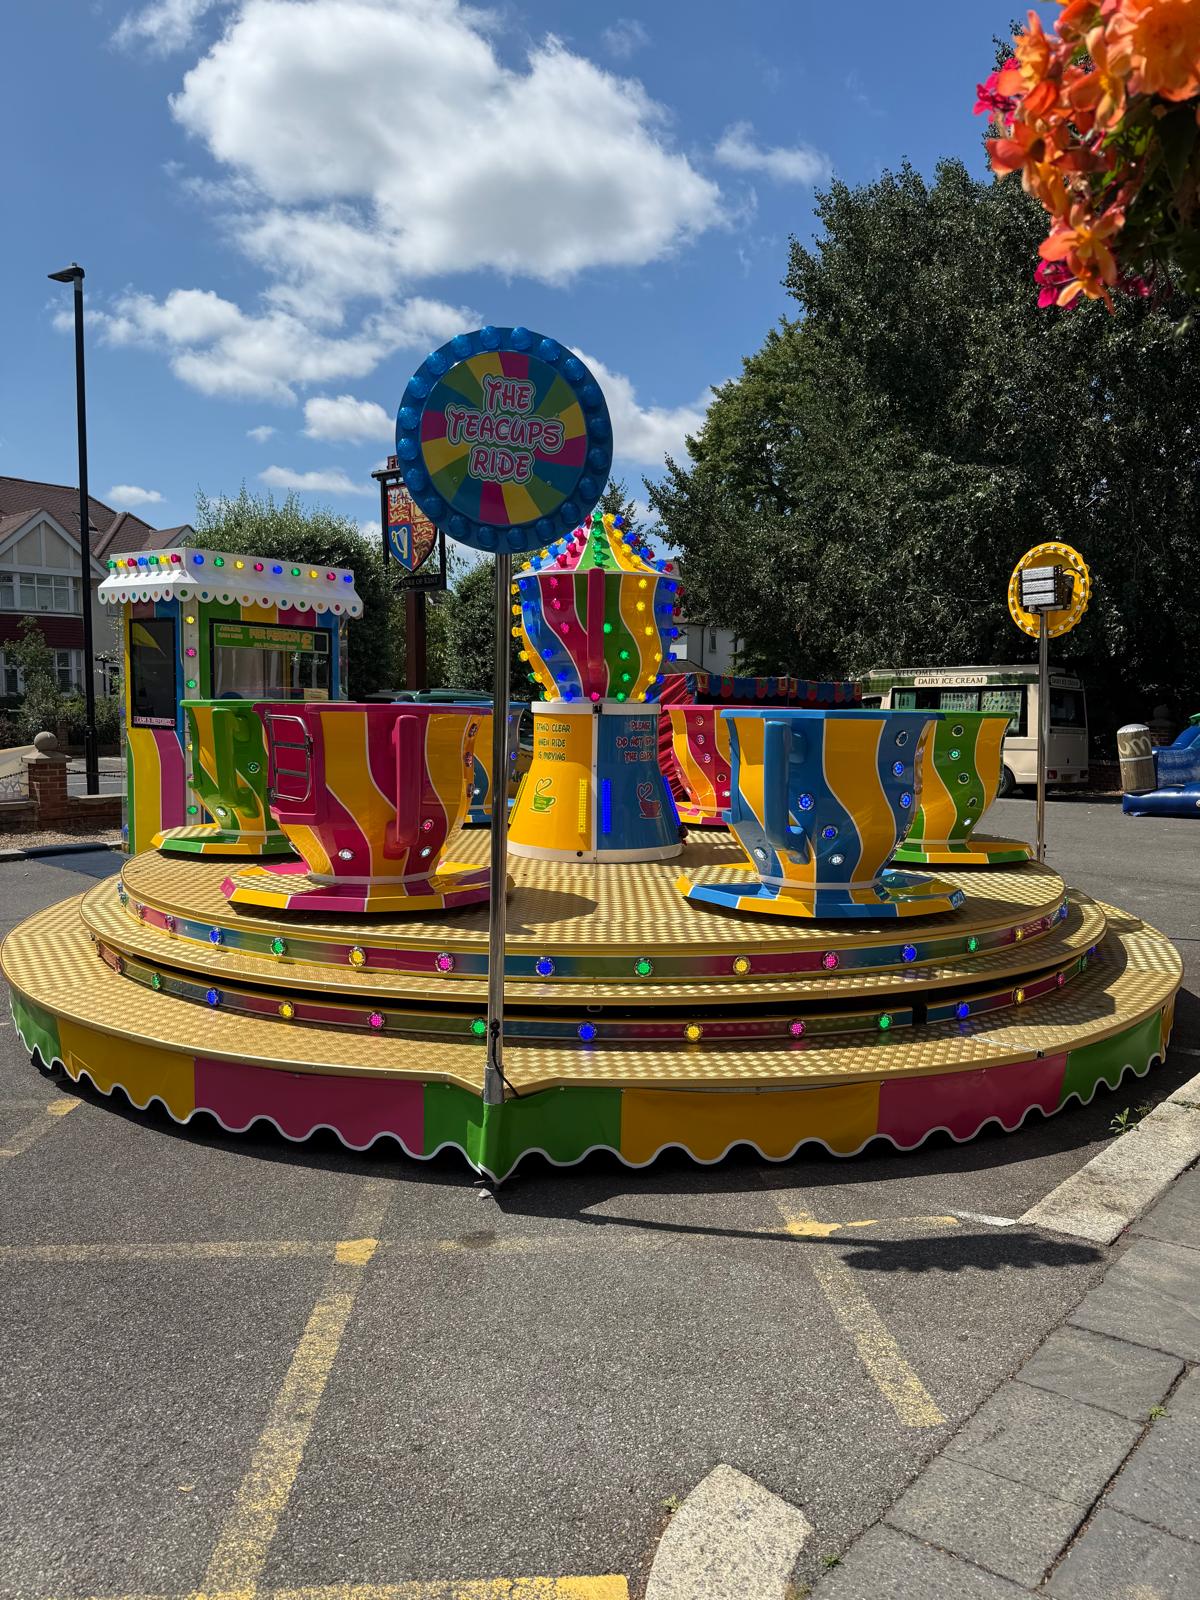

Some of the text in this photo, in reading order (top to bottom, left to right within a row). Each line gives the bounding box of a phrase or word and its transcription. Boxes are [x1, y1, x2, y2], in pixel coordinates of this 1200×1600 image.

[485, 376, 533, 412] THE
[449, 405, 563, 450] TEACUPS
[472, 446, 532, 480] RIDE
[955, 677, 983, 685] CREAM
[552, 723, 571, 733] CLEAR
[551, 738, 566, 747] RIDE
